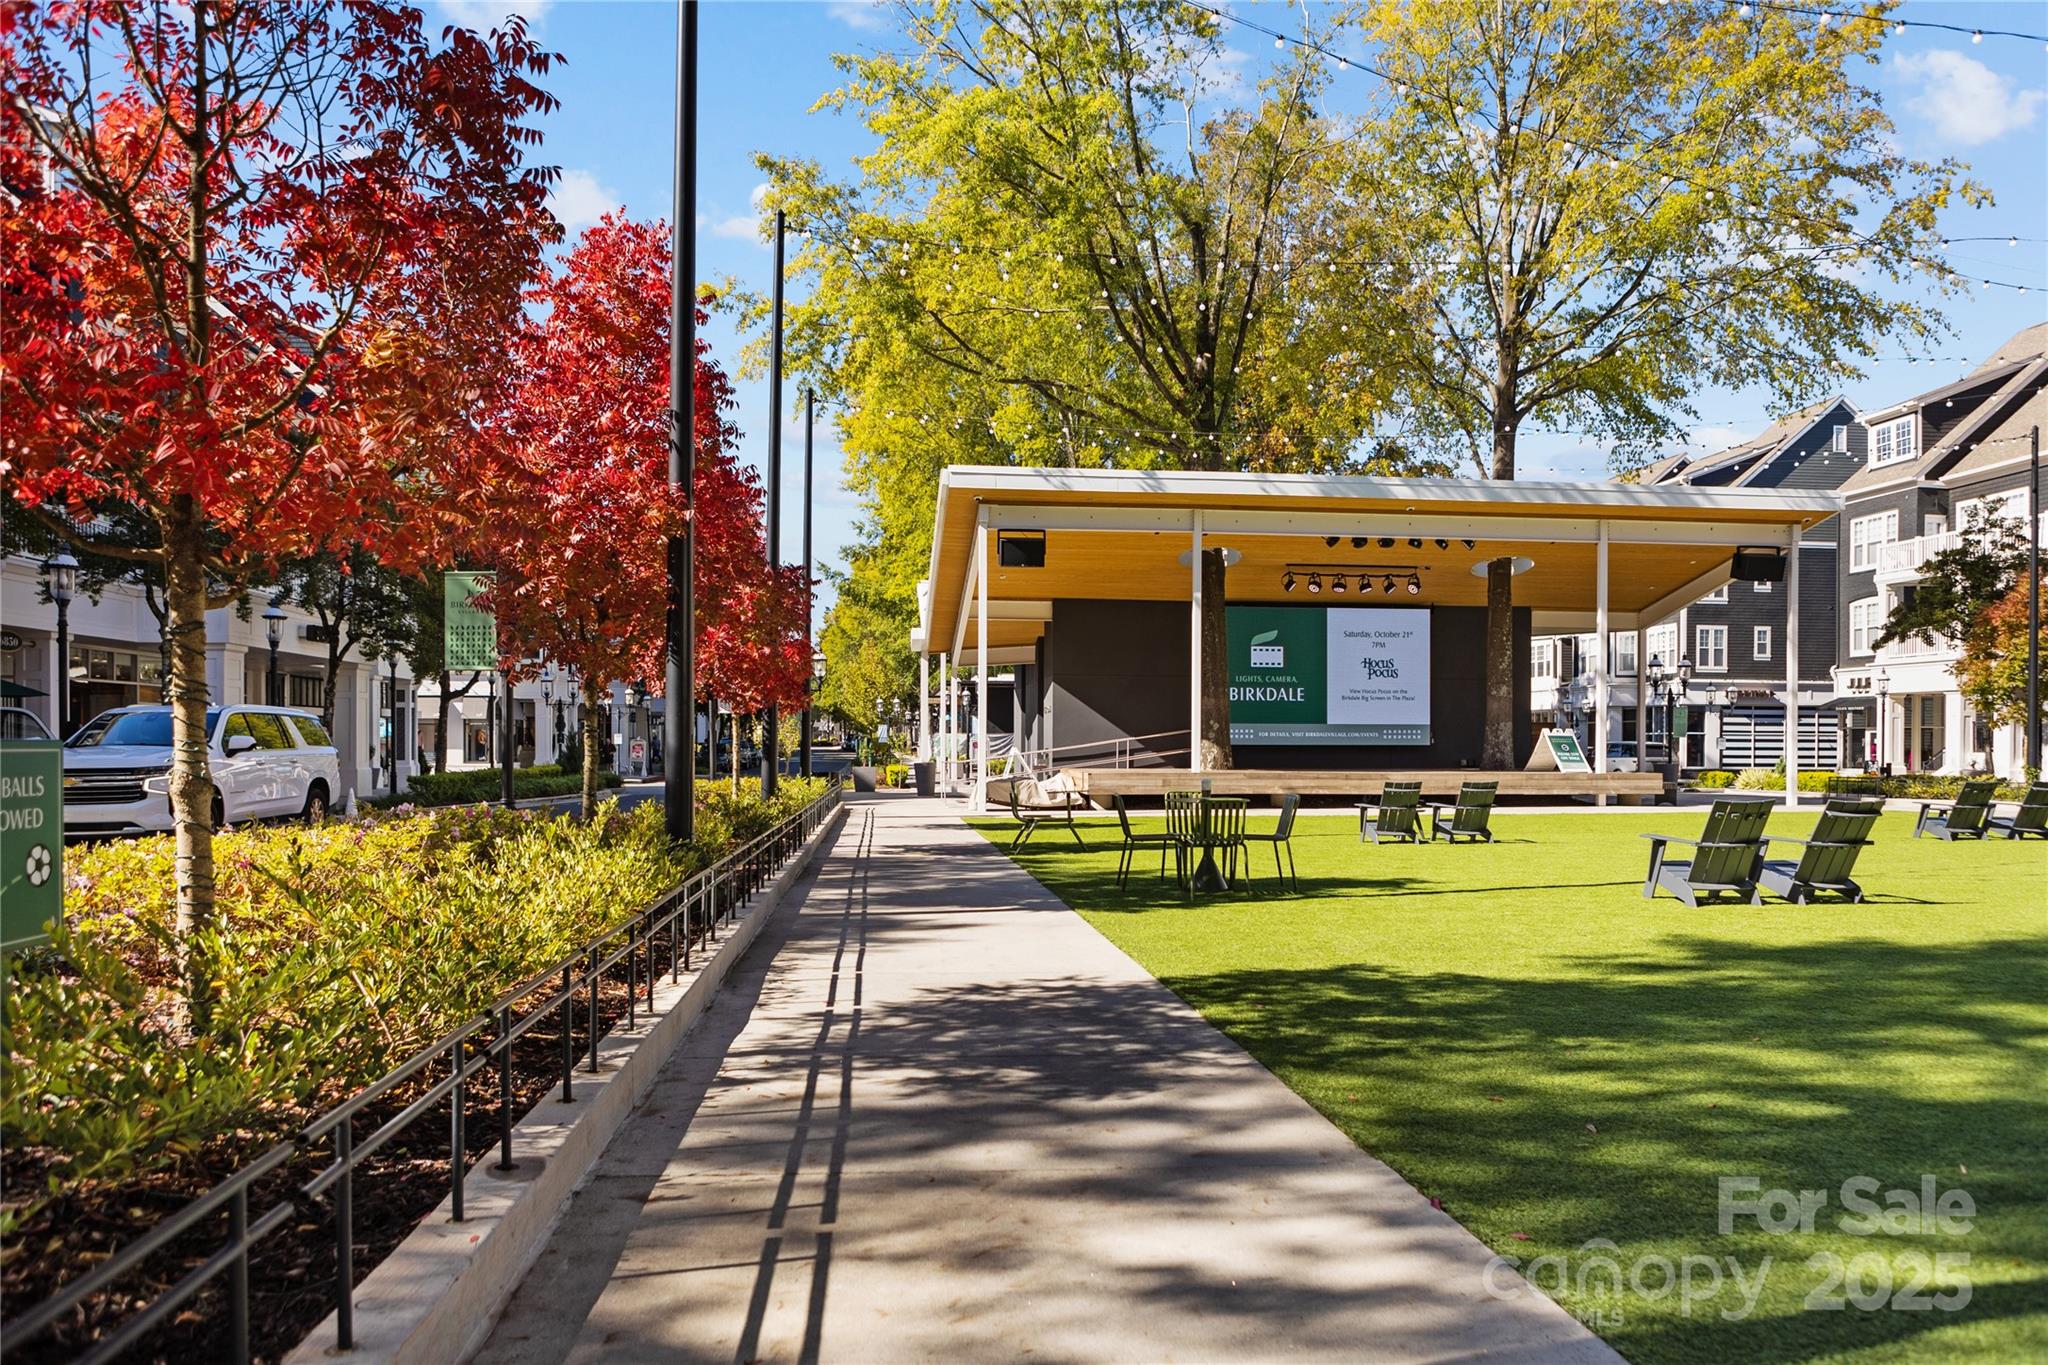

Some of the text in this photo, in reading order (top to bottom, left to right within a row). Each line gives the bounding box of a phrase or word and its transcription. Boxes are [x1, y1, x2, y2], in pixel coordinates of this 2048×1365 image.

[1344, 631, 1373, 639] Saturday,
[1230, 688, 1305, 702] BIRKDALE
[2, 775, 45, 798] BALLS
